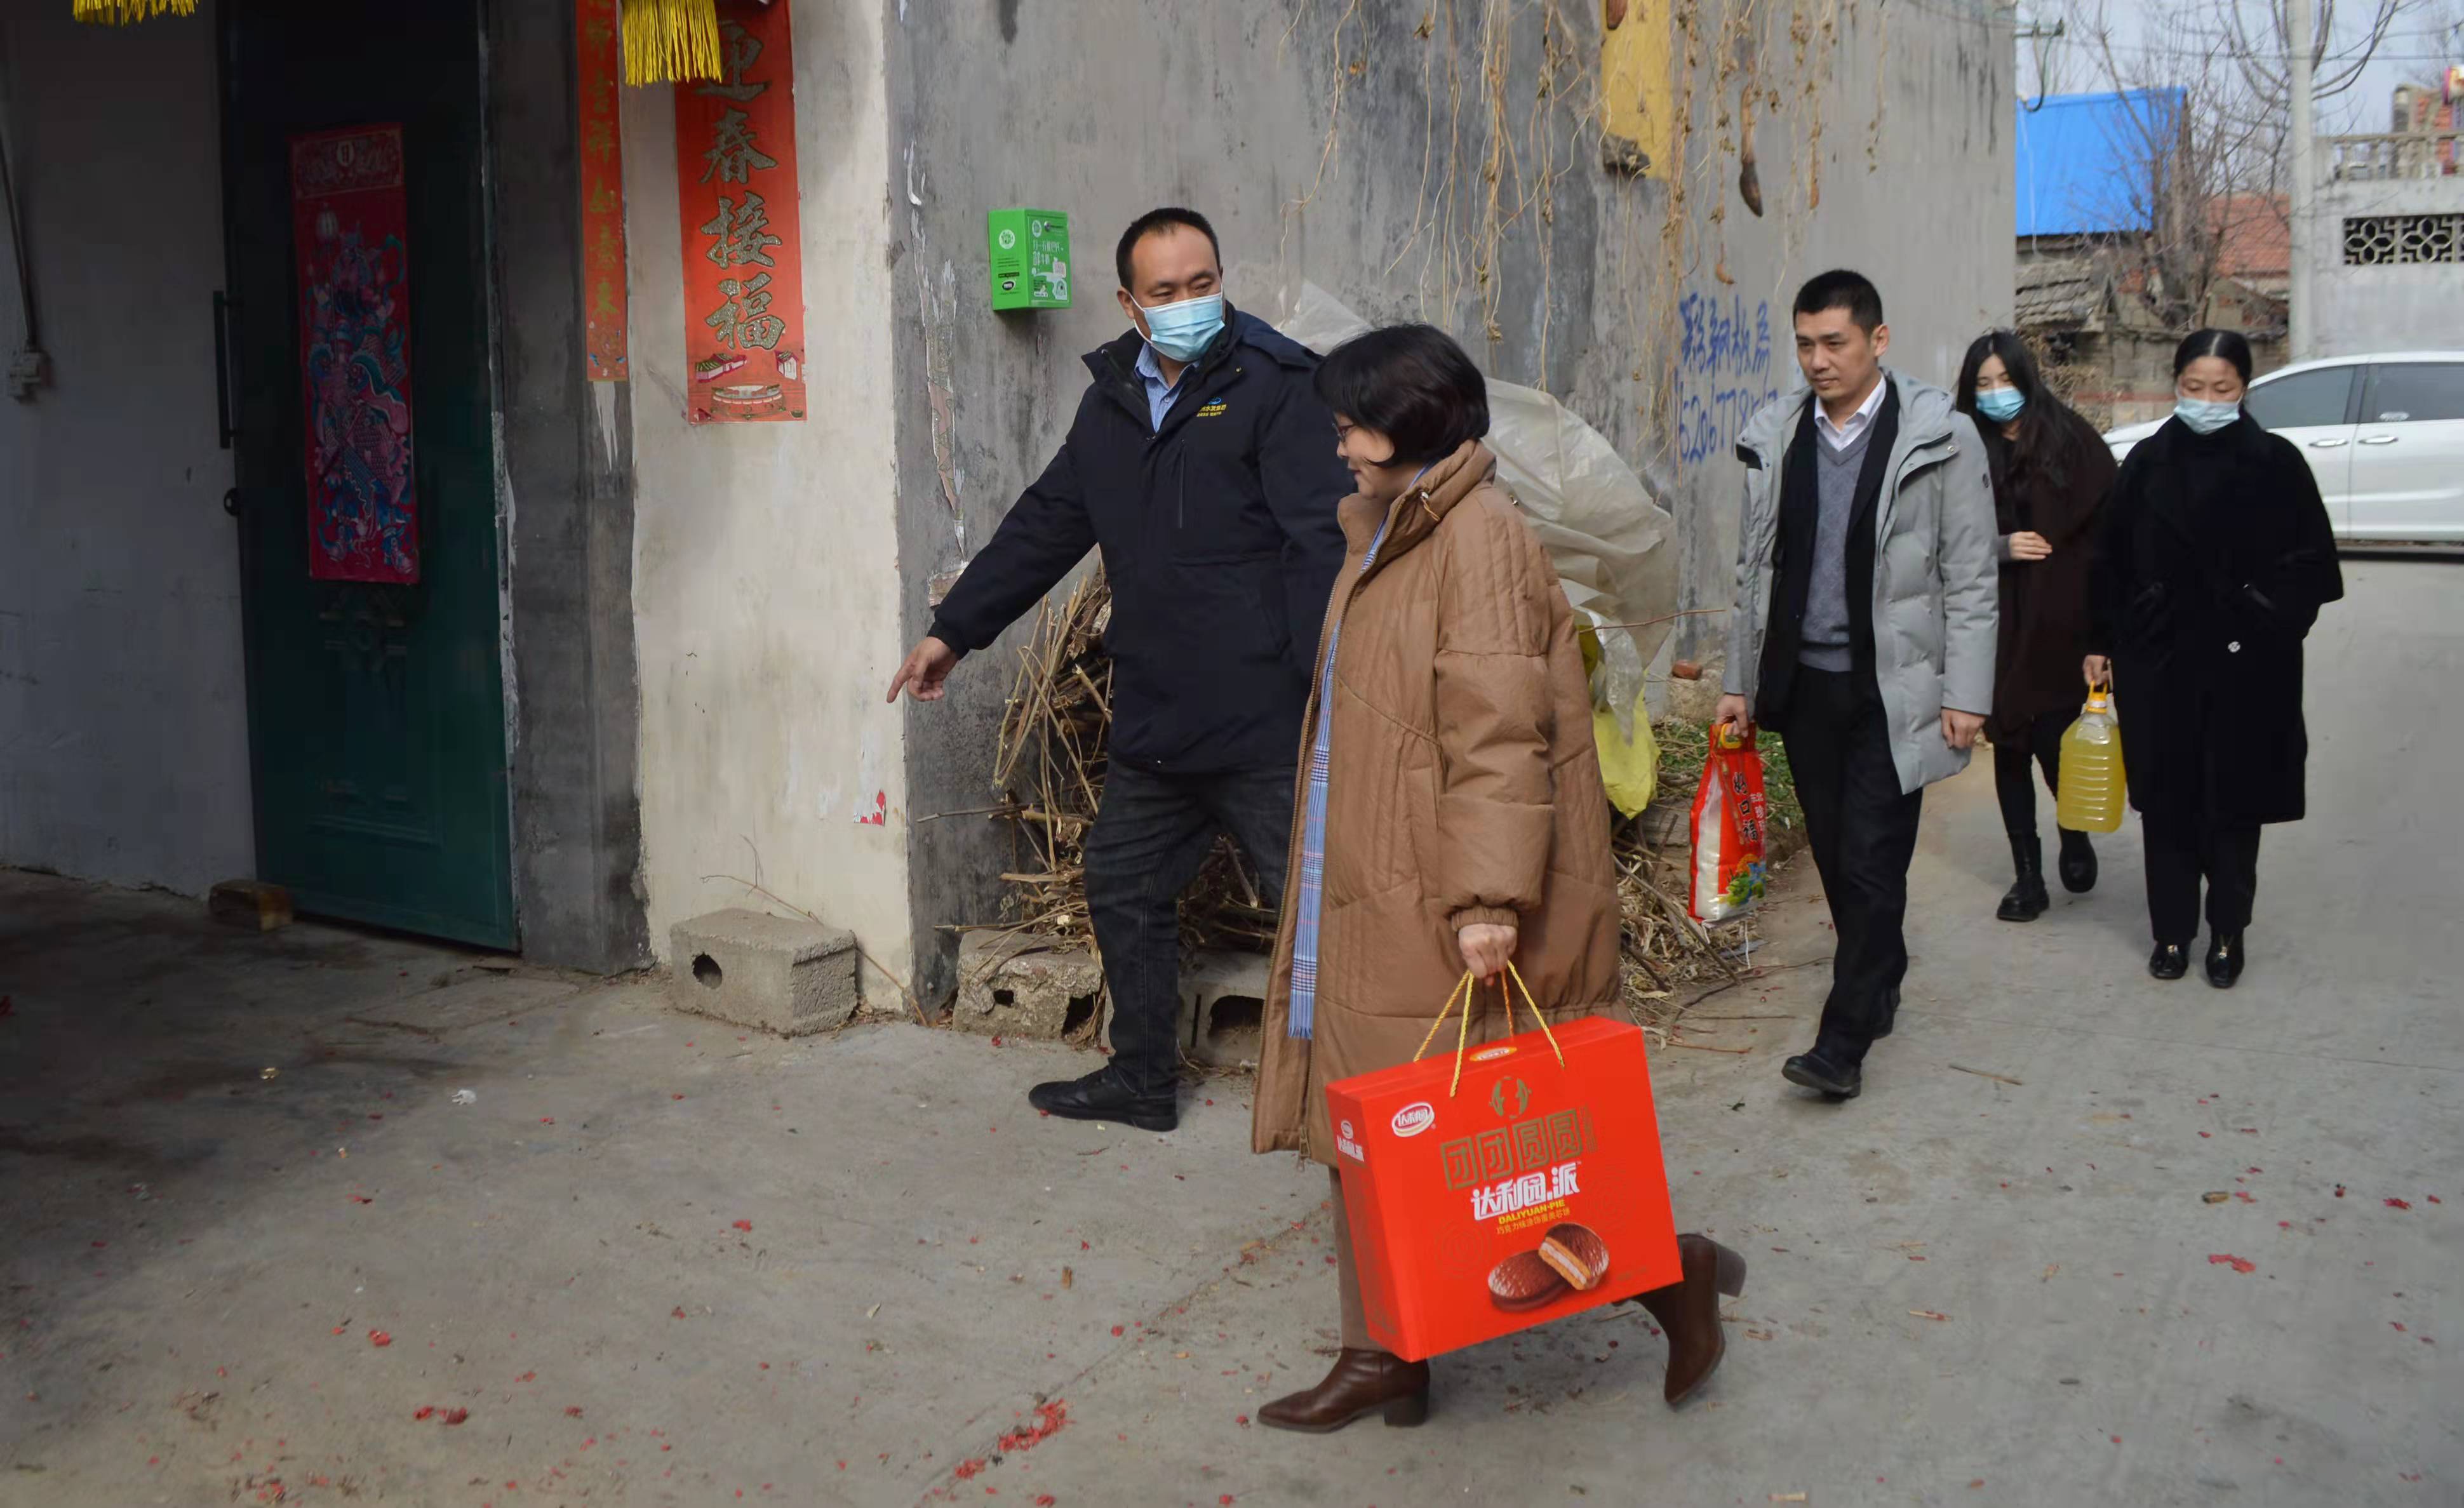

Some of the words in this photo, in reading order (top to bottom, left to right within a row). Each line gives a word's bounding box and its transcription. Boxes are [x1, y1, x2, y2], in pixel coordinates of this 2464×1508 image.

[695, 20, 785, 350] 迎春接福
[1440, 1108, 1583, 1191] 团团圆圆
